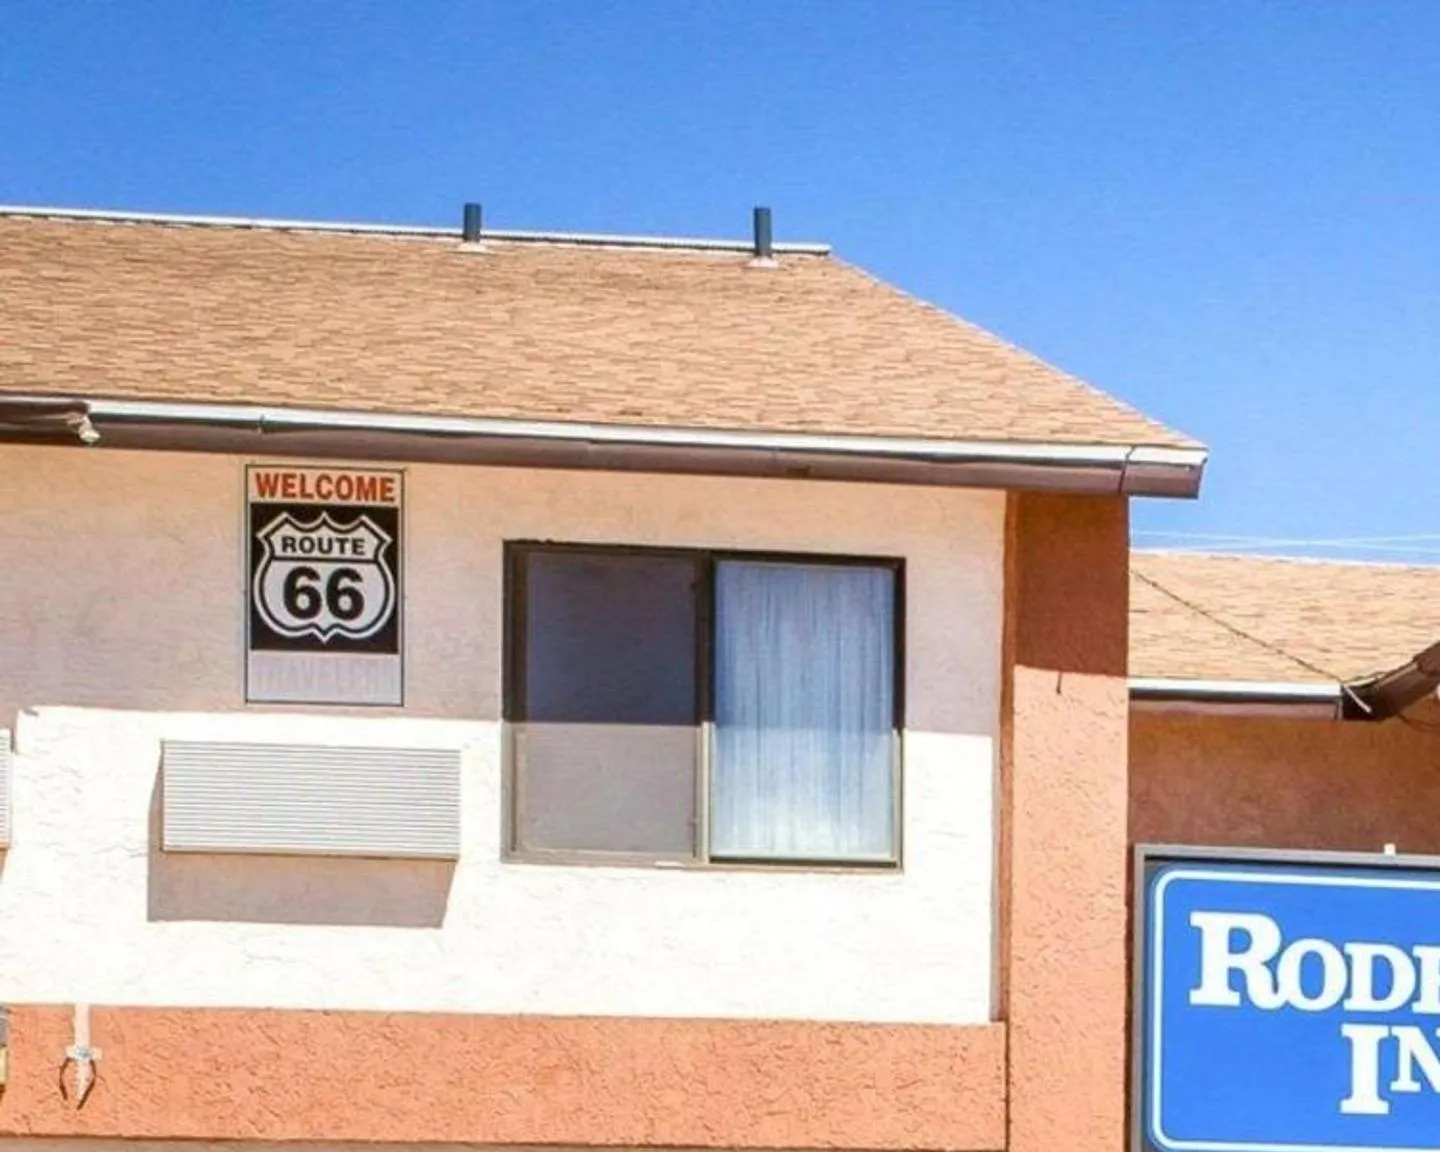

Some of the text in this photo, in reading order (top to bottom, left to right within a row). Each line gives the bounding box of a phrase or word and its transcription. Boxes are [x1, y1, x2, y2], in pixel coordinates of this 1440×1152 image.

[255, 472, 395, 502] WELCOME
[281, 535, 366, 556] ROUTE
[283, 565, 366, 622] 66
